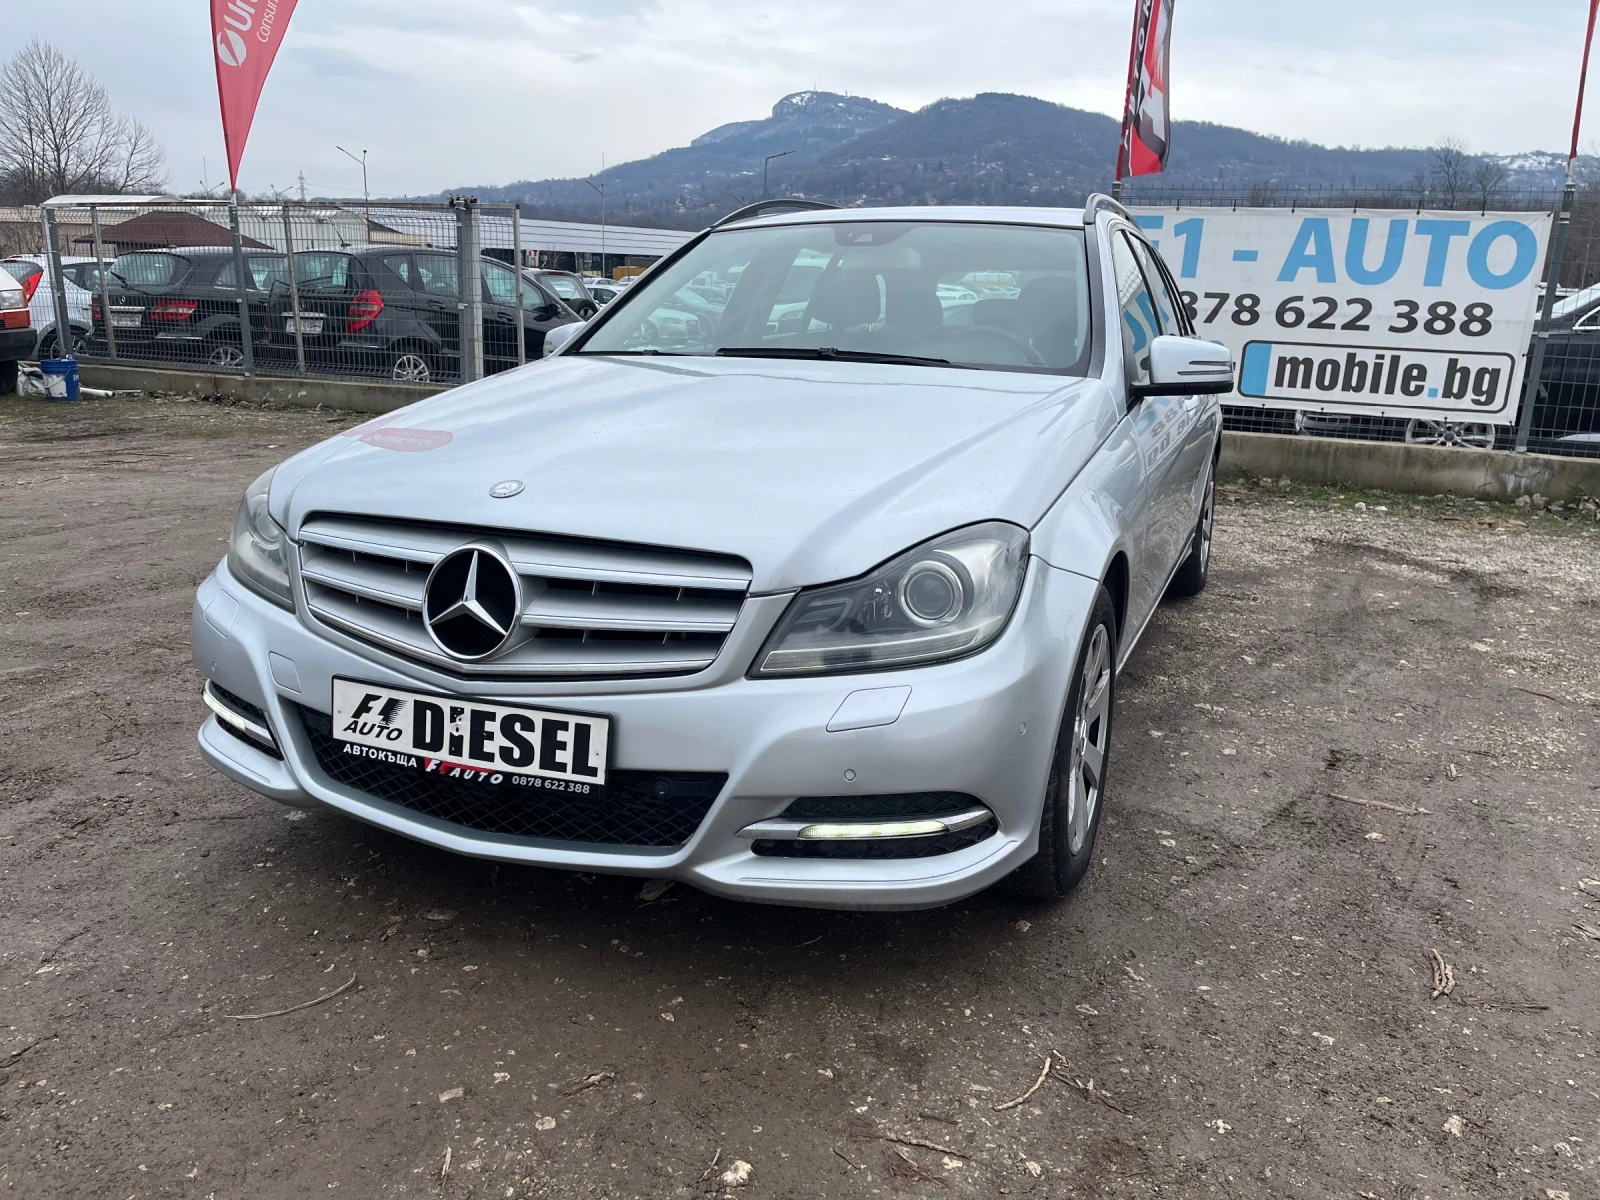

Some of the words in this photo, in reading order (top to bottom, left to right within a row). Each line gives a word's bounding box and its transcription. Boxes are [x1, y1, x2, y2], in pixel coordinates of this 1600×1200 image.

[256, 0, 279, 43] Consu
[1232, 249, 1259, 262] -
[1276, 217, 1538, 290] AUTO
[1274, 295, 1373, 332] 622
[1388, 299, 1494, 337] 388
[1273, 352, 1502, 406] mobile.bg
[351, 693, 408, 726] F1
[342, 720, 403, 741] AUTO
[412, 699, 598, 777] DIESEL
[343, 743, 418, 768] АВТОКЪЩА
[450, 767, 504, 784] AUTO
[511, 775, 542, 788] 0878
[544, 780, 565, 791] 622
[567, 782, 590, 794] 388
